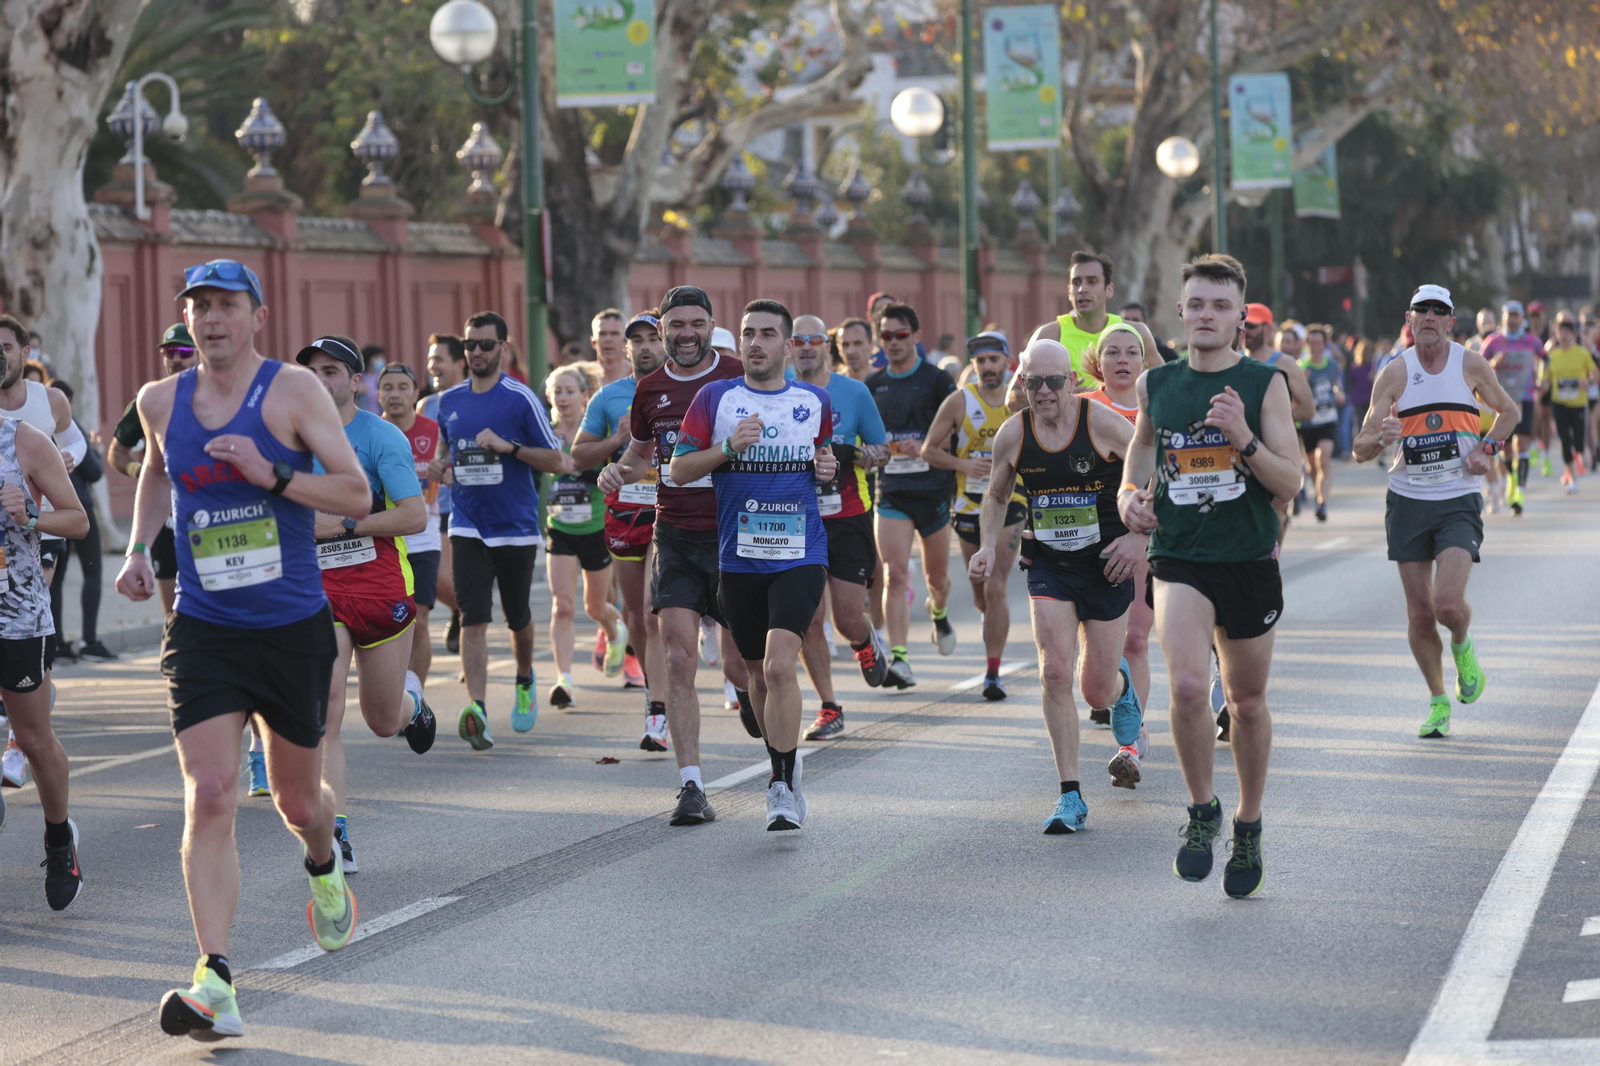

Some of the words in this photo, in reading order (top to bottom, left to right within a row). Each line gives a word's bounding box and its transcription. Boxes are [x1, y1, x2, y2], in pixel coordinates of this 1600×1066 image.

[654, 419, 683, 428] Delegació
[1186, 433, 1229, 445] ZRICH
[1418, 433, 1451, 446] ZURICH
[740, 444, 811, 462] FORMALES
[1421, 451, 1441, 462] 3157
[739, 462, 807, 472] ANIVERSARIO
[1190, 456, 1215, 468] 4989
[1421, 464, 1445, 472] CATHAL
[1188, 474, 1220, 485] 300896
[1051, 496, 1088, 505] ZURICH
[760, 503, 798, 512] ZURICH
[212, 504, 264, 524] ZURICH
[1054, 515, 1076, 525] 1323
[757, 522, 786, 531] 11700
[1054, 529, 1079, 538] BARRY
[217, 534, 248, 549] 1138
[752, 536, 789, 545] MONCAYO
[320, 543, 342, 555] JESÚS
[343, 540, 363, 551] ALBA
[225, 556, 245, 568] KEV
